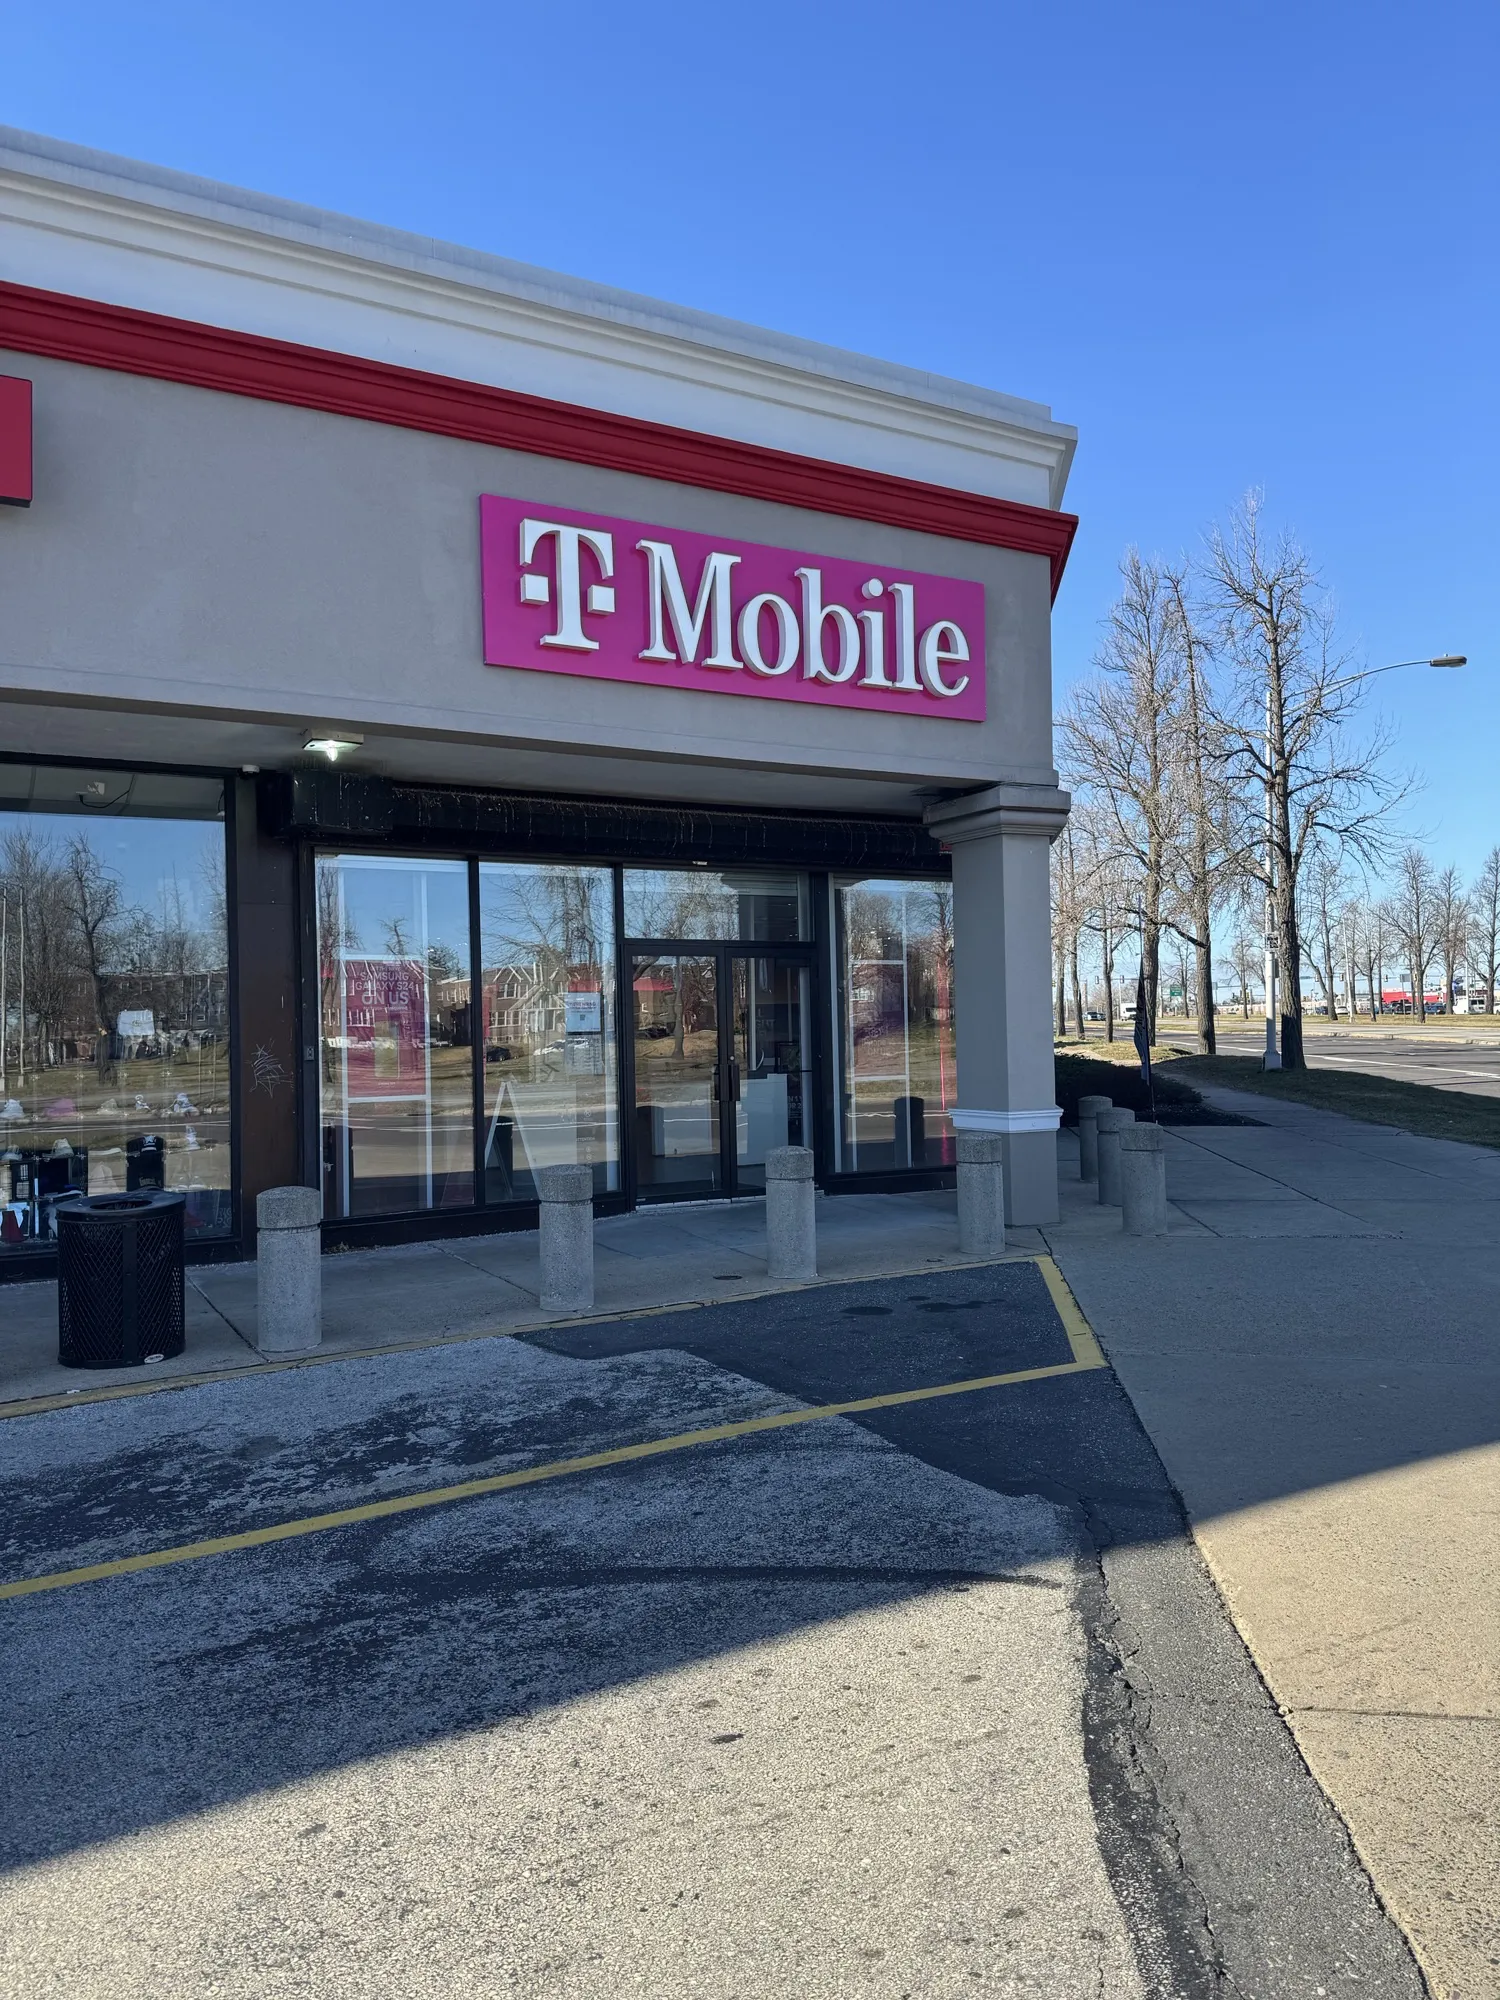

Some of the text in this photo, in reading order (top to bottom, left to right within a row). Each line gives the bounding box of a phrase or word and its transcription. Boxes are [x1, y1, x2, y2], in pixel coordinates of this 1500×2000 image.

[636, 539, 970, 697] Mobile
[360, 971, 409, 981] SAMSUNG
[396, 981, 414, 991] S24
[361, 991, 409, 1005] ON US
